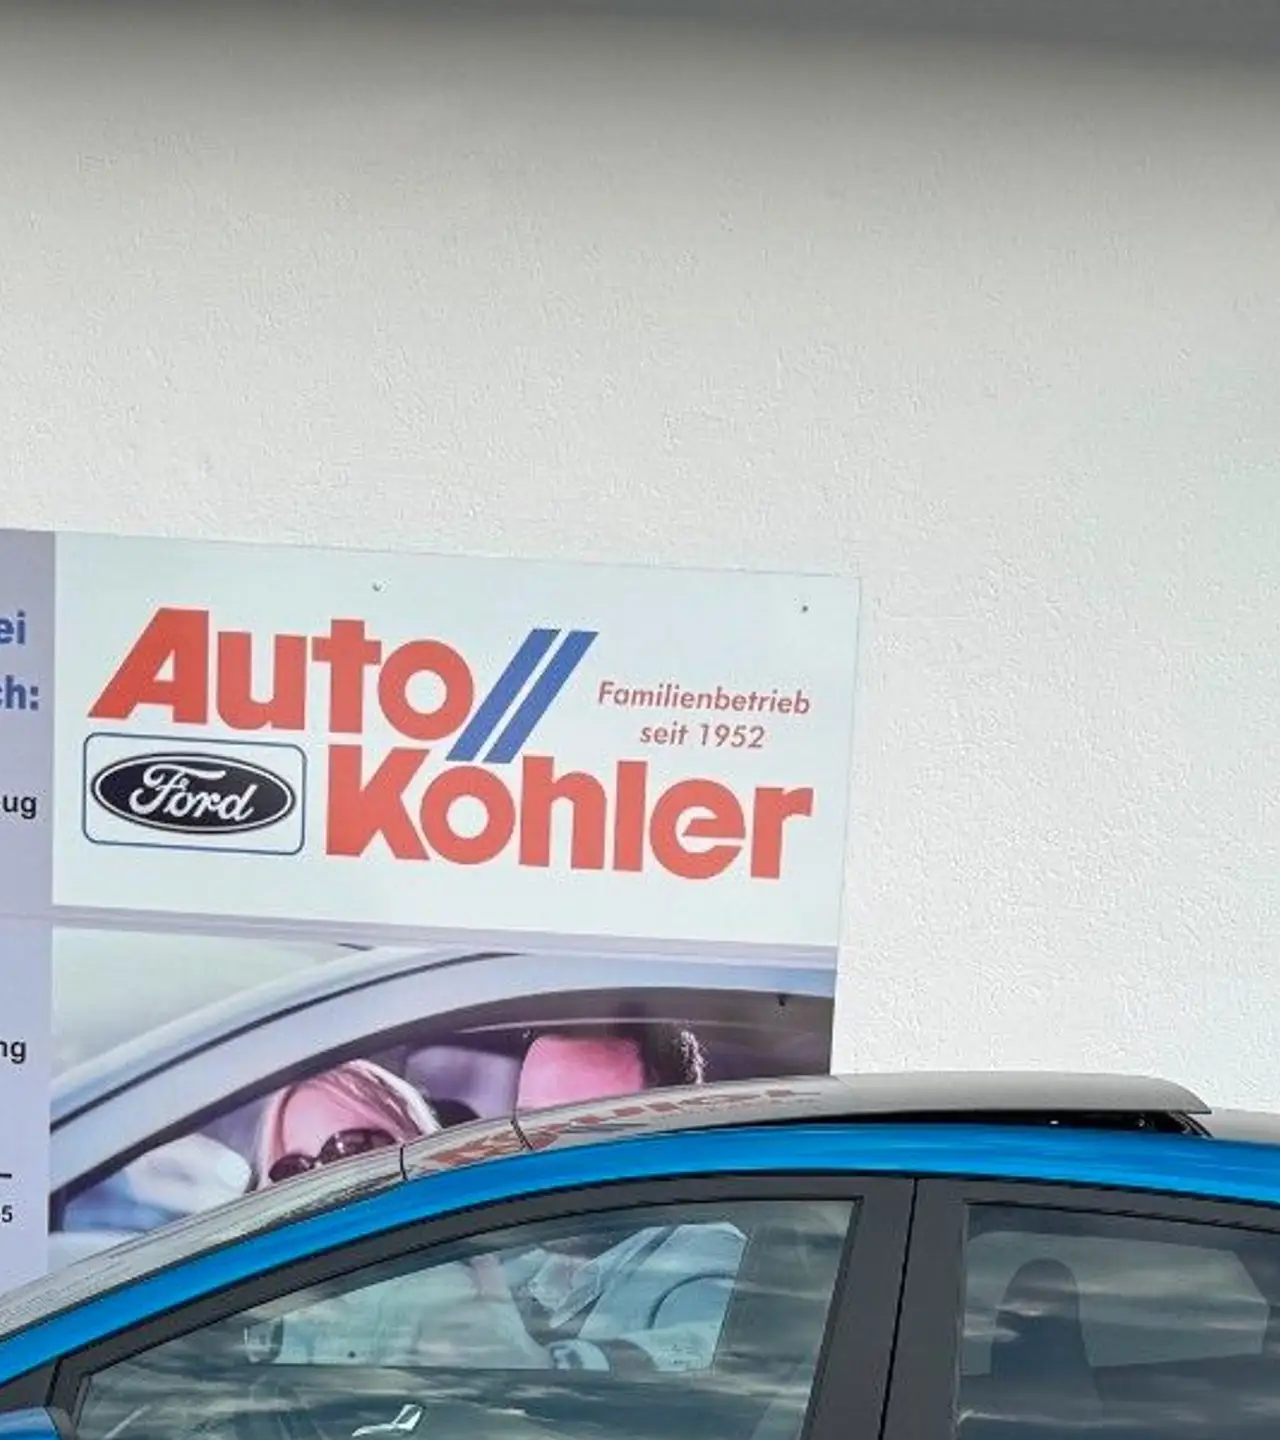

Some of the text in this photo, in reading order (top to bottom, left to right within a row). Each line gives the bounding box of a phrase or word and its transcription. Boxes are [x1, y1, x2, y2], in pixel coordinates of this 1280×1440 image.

[87, 607, 475, 741] Auto
[599, 681, 810, 714] Familienbetrieb
[640, 721, 765, 748] seit 1952
[128, 763, 258, 822] Ford
